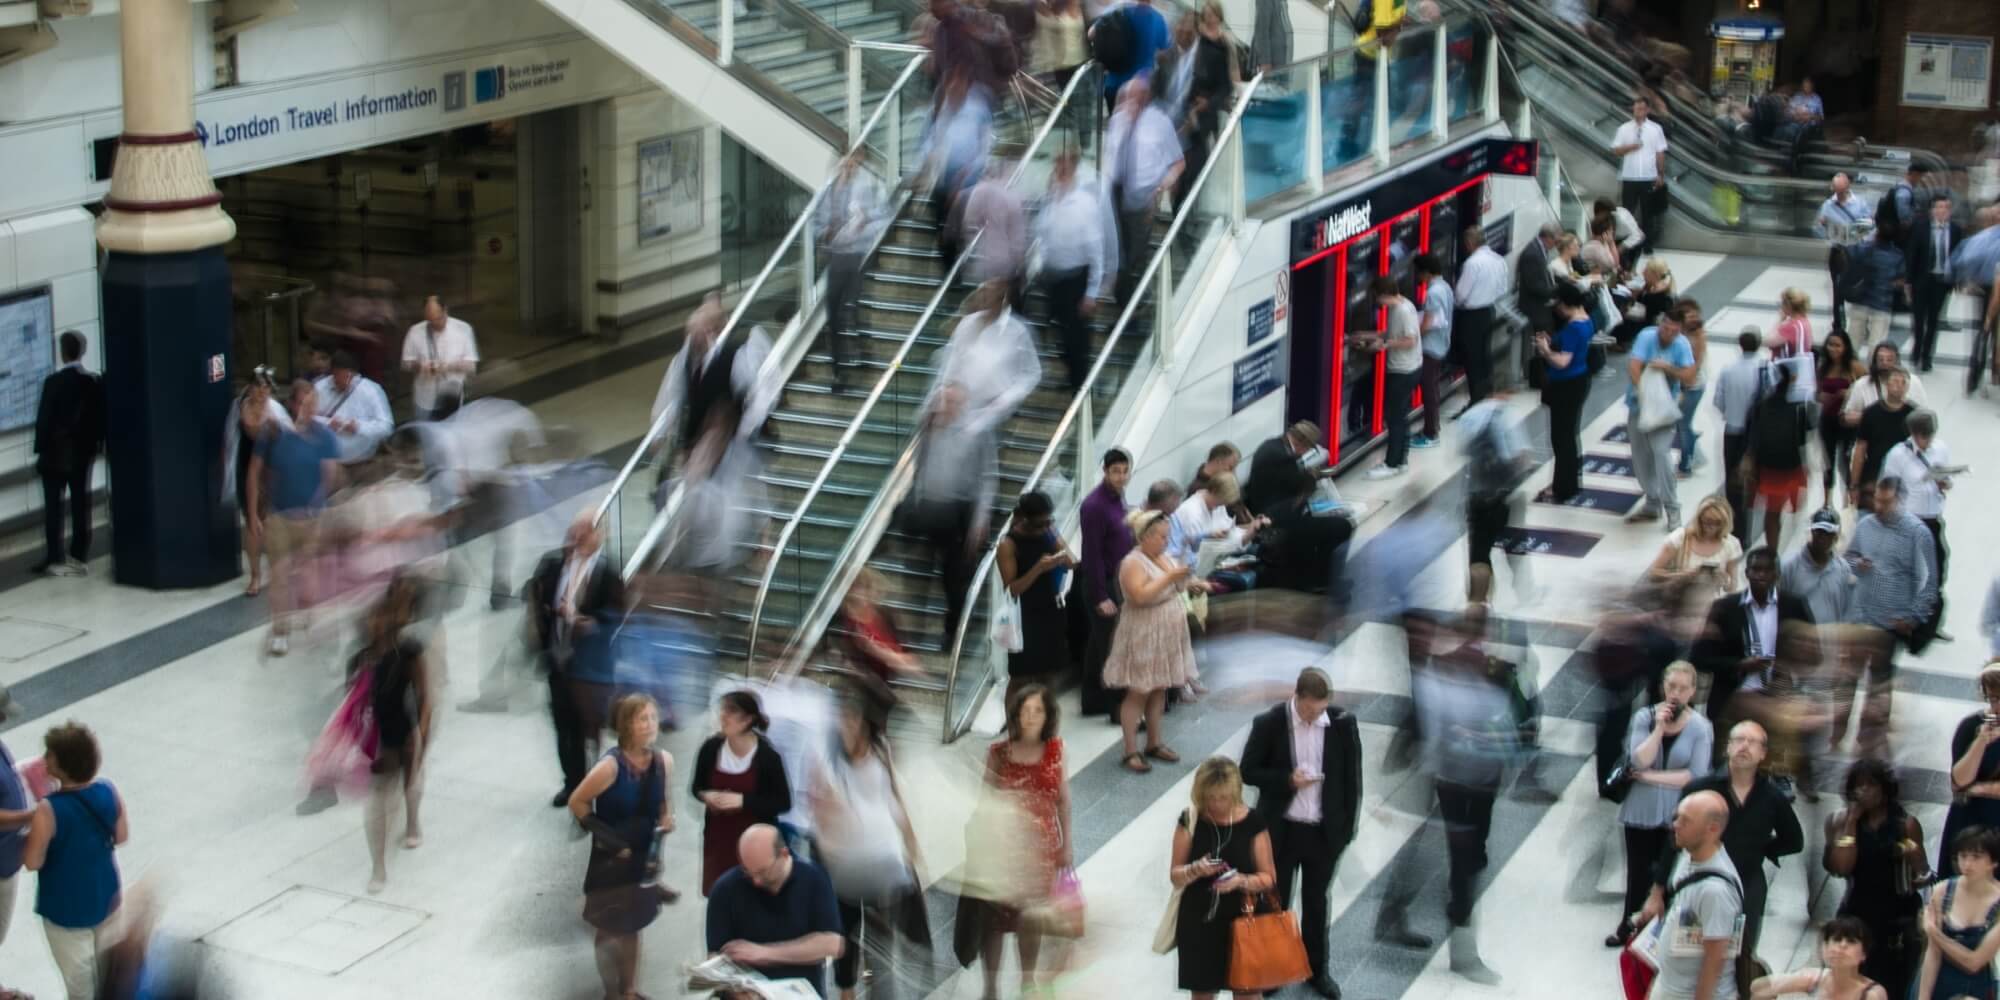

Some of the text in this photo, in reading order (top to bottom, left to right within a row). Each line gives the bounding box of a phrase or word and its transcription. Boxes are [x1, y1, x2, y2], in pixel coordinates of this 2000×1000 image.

[215, 86, 437, 146] London Travel Information
[1328, 200, 1371, 247] NatWest
